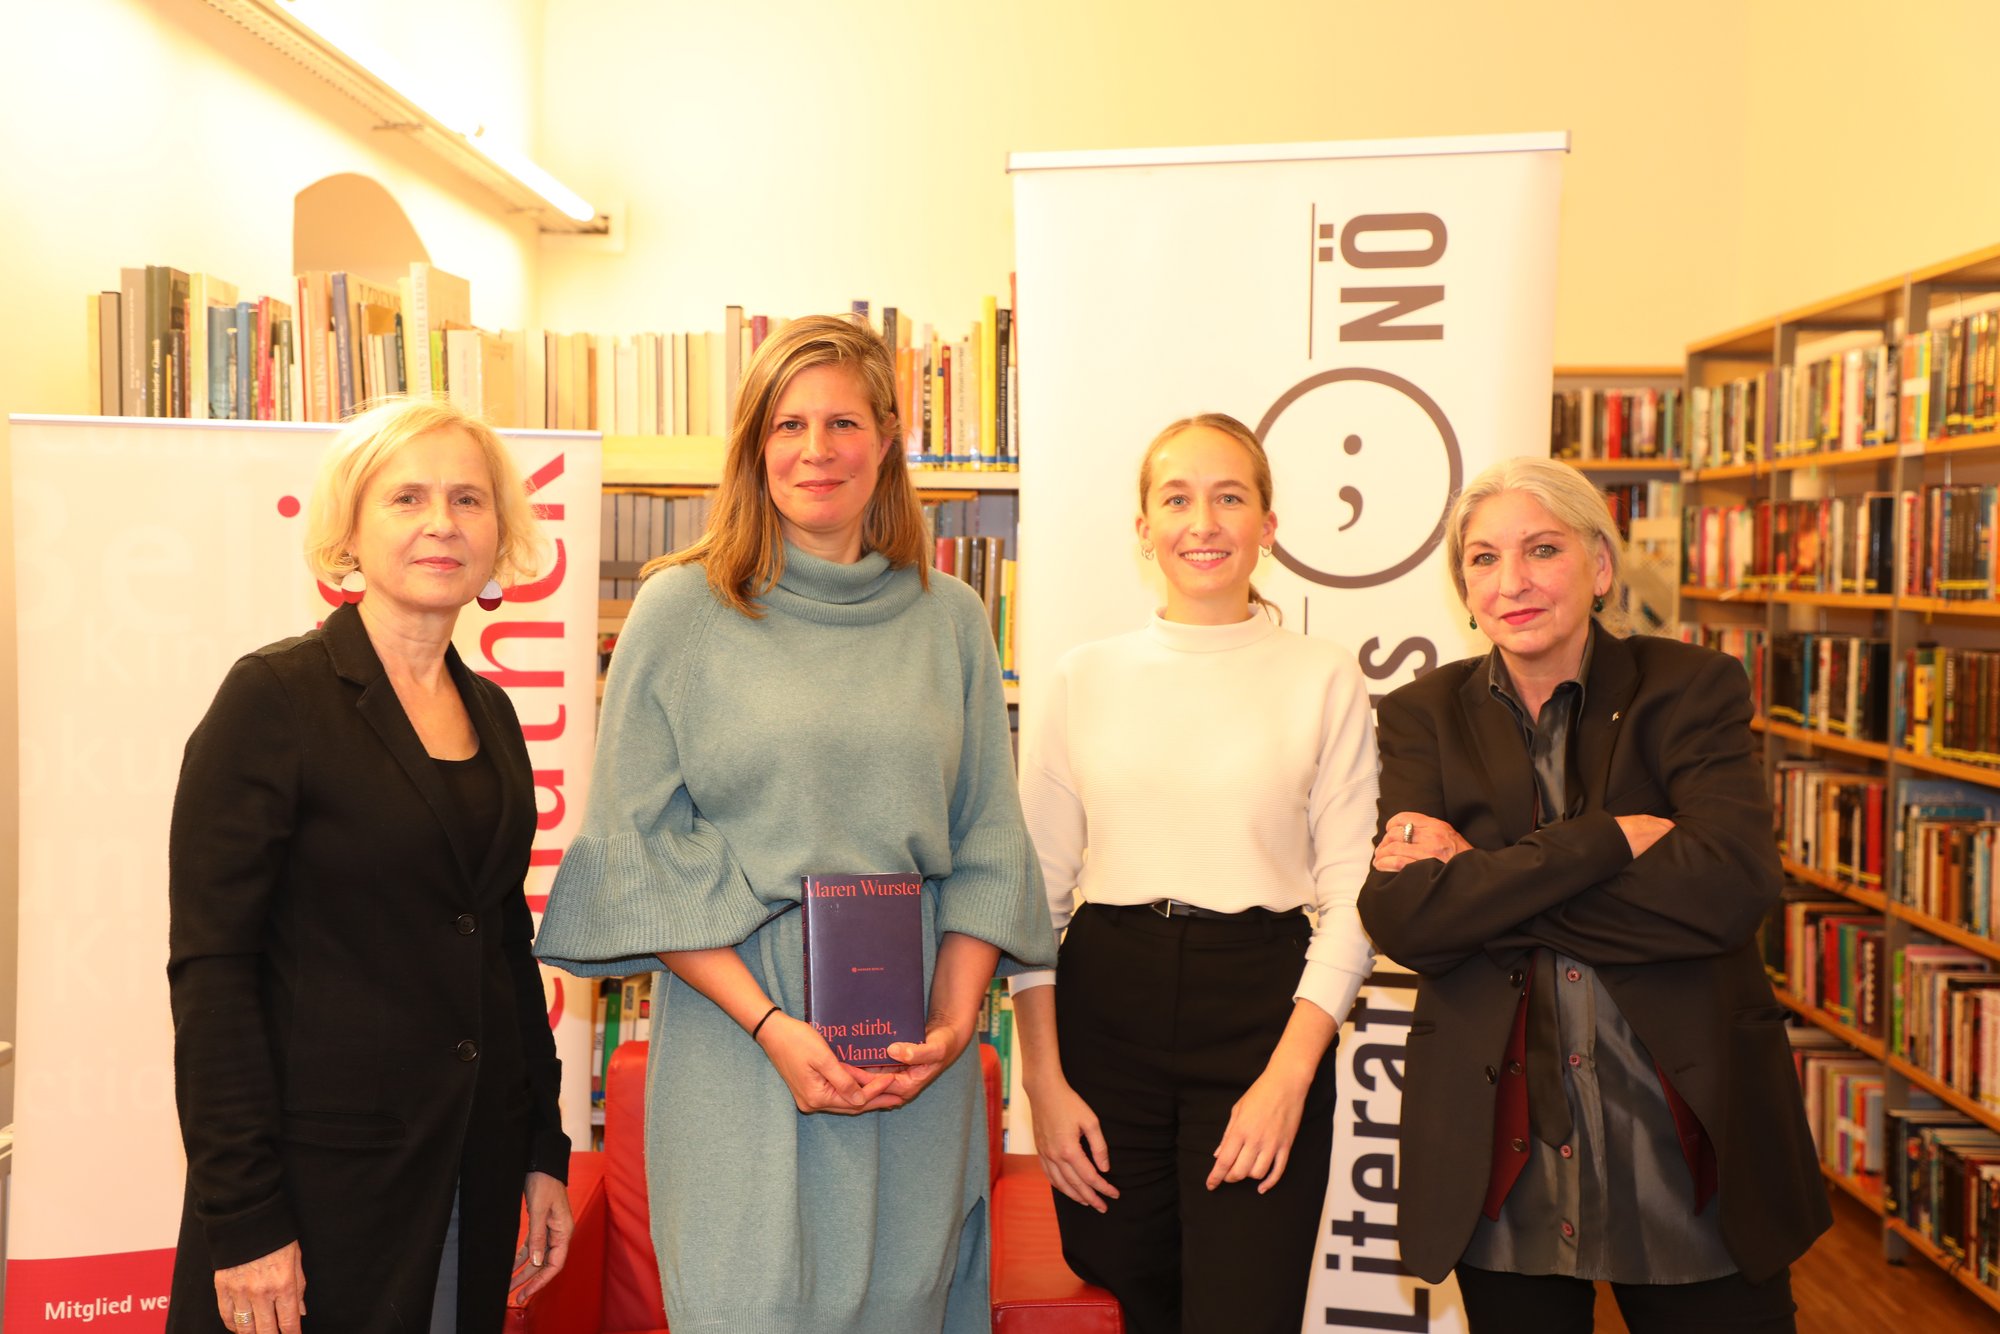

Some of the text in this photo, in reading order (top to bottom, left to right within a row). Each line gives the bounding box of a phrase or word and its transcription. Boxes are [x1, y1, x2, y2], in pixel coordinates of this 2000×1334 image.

[1318, 211, 1449, 342] NÖ
[803, 880, 921, 899] Maren Wurster
[851, 1018, 897, 1036] stirbt,
[837, 1044, 888, 1061] Mama
[44, 1294, 171, 1322] Mitglied we
